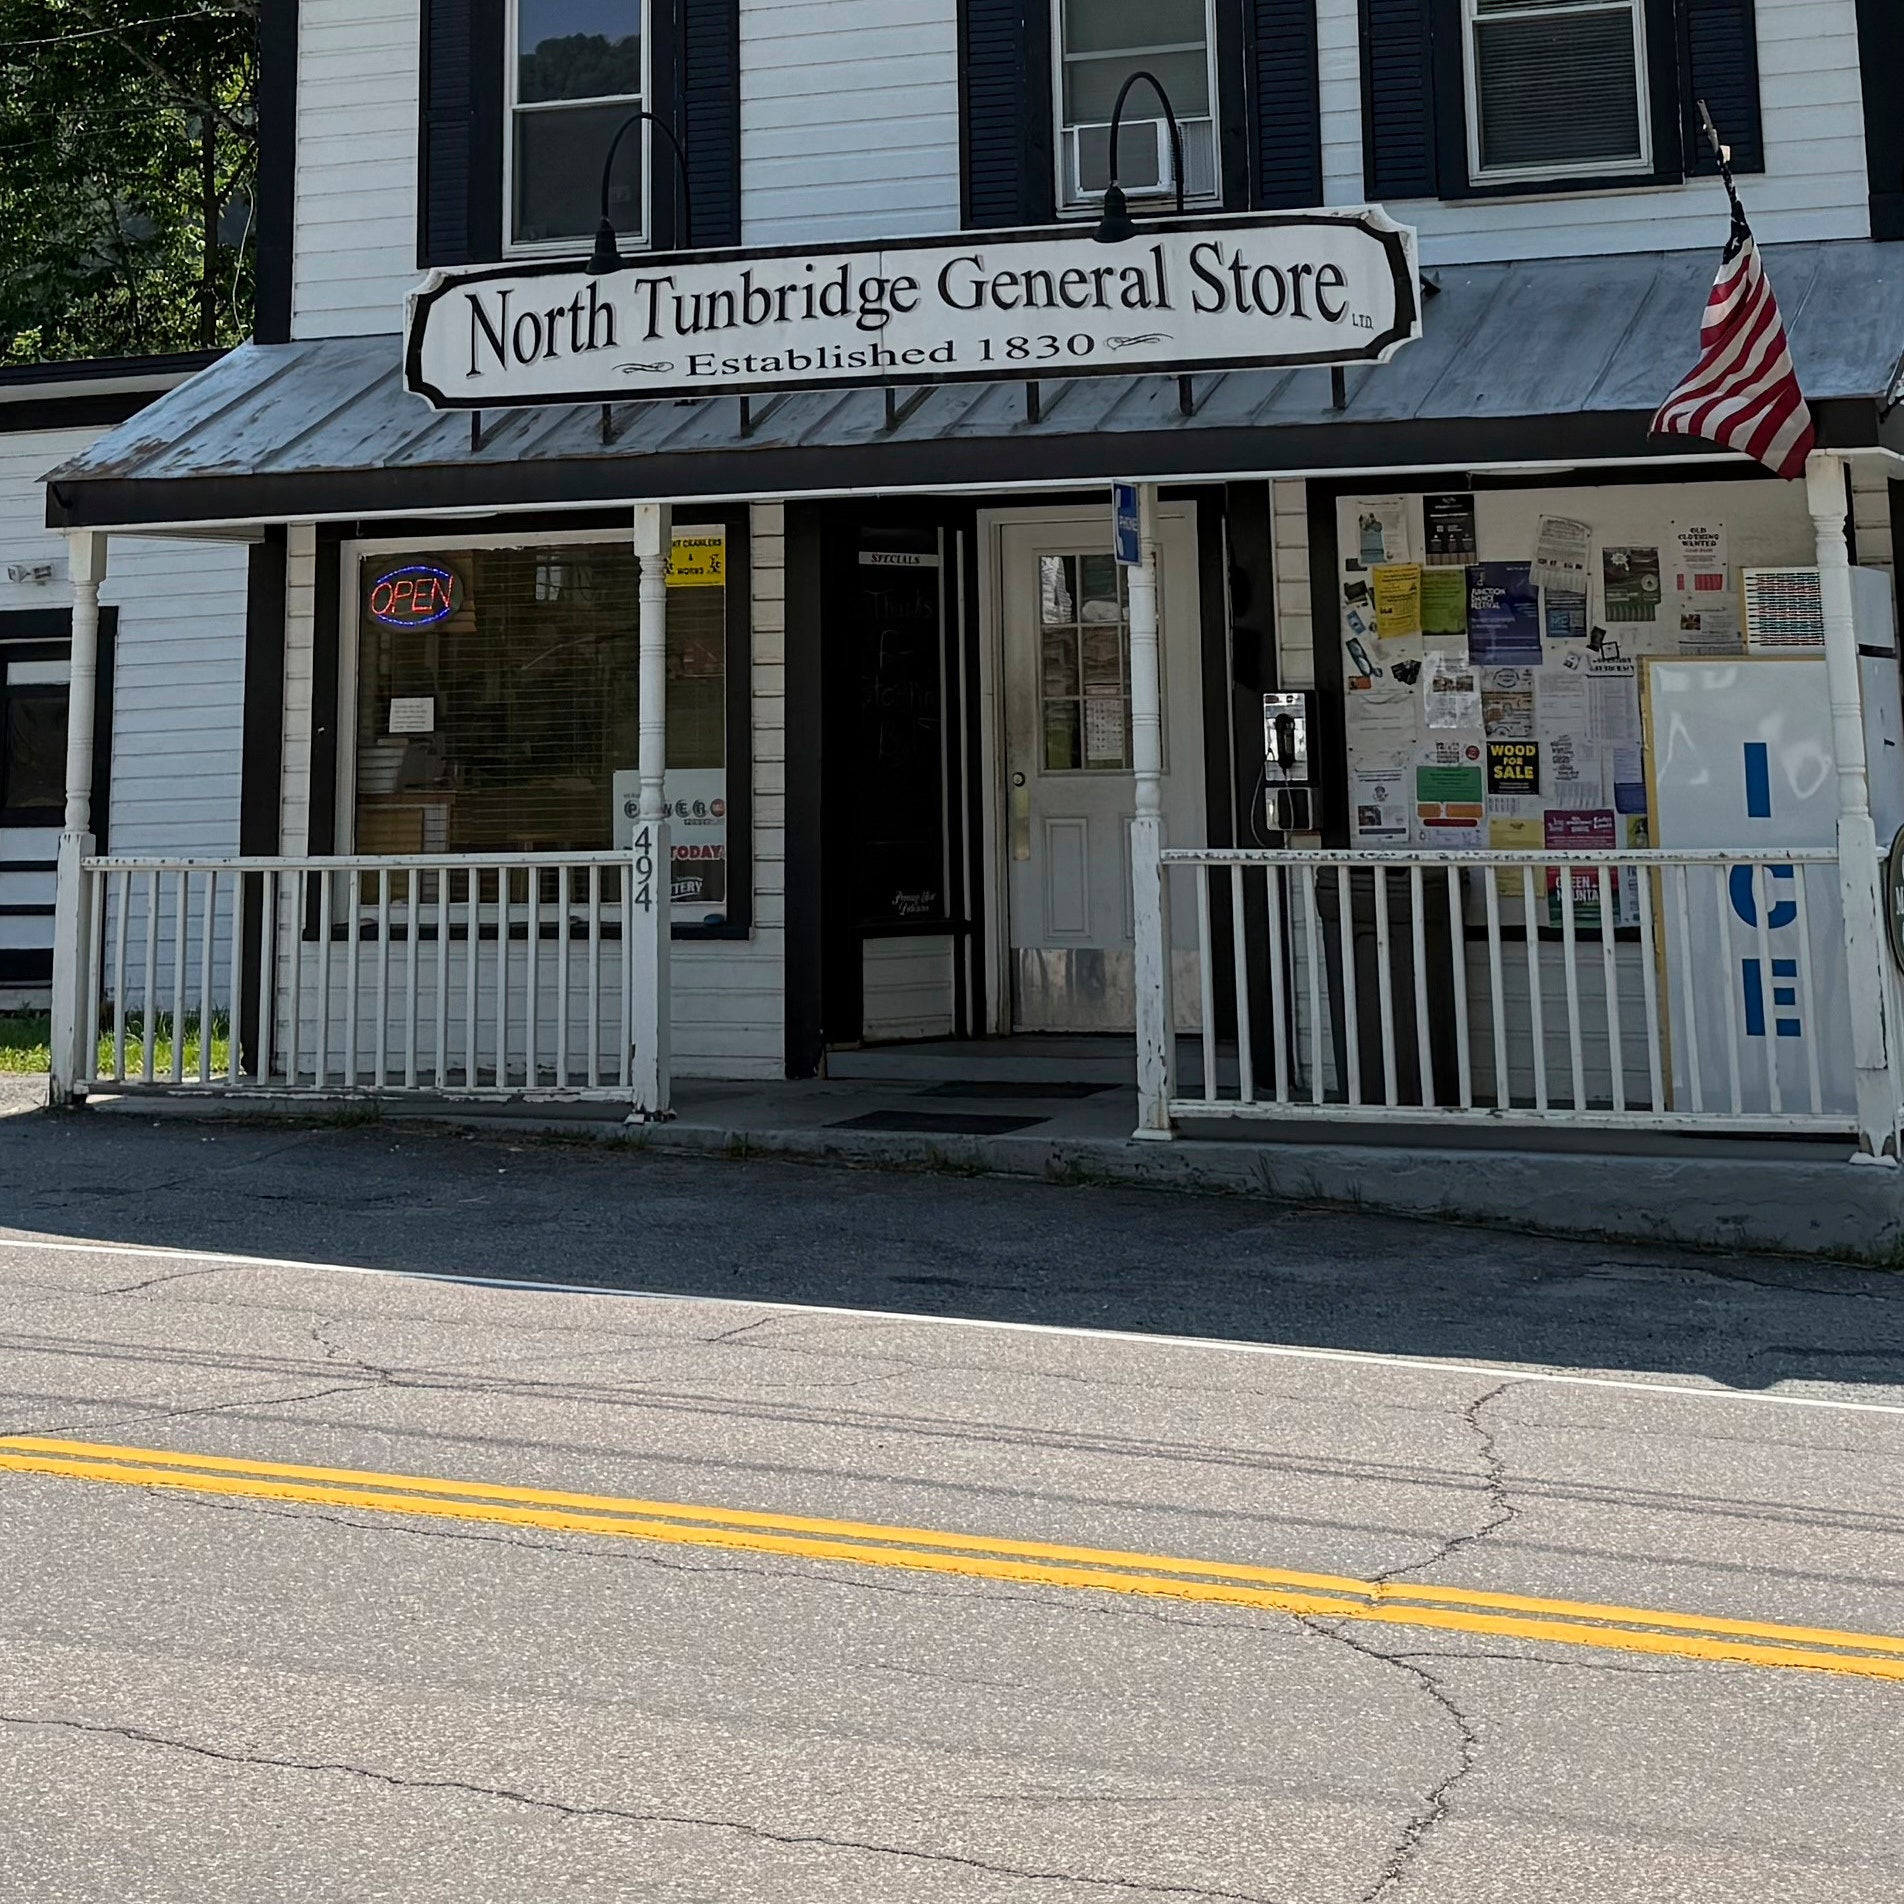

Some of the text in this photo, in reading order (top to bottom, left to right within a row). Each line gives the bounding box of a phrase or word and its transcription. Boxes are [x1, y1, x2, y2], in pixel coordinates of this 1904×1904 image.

[465, 280, 619, 379] North
[633, 262, 921, 342] Tunbridge
[937, 243, 1175, 312] General
[1188, 240, 1349, 323] Store
[685, 333, 1095, 377] Established 1830
[871, 553, 921, 565] SPECIALS
[371, 575, 454, 615] OPEN
[1491, 745, 1536, 756] WOOD
[1503, 756, 1523, 765] FOR
[1494, 765, 1534, 780] SALE
[634, 826, 653, 913] 494
